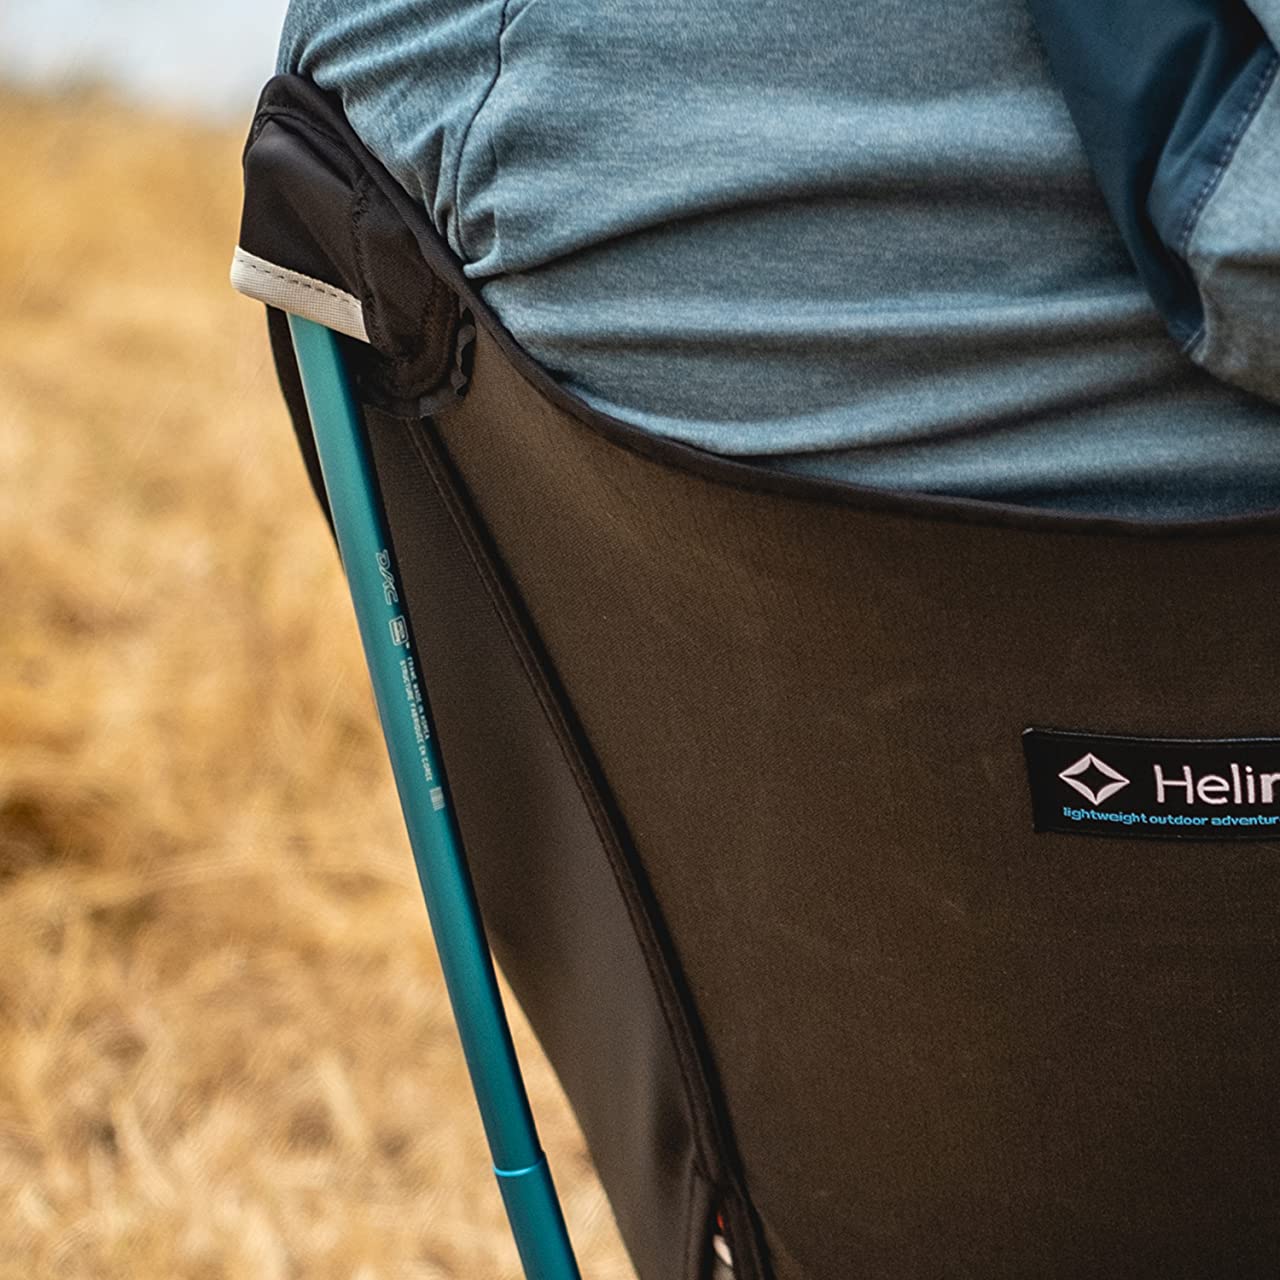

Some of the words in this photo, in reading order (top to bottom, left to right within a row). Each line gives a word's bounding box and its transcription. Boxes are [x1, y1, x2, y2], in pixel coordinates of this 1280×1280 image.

[375, 549, 398, 605] DAC
[1063, 806, 1148, 825] lightweight
[1148, 812, 1208, 826] outdoor
